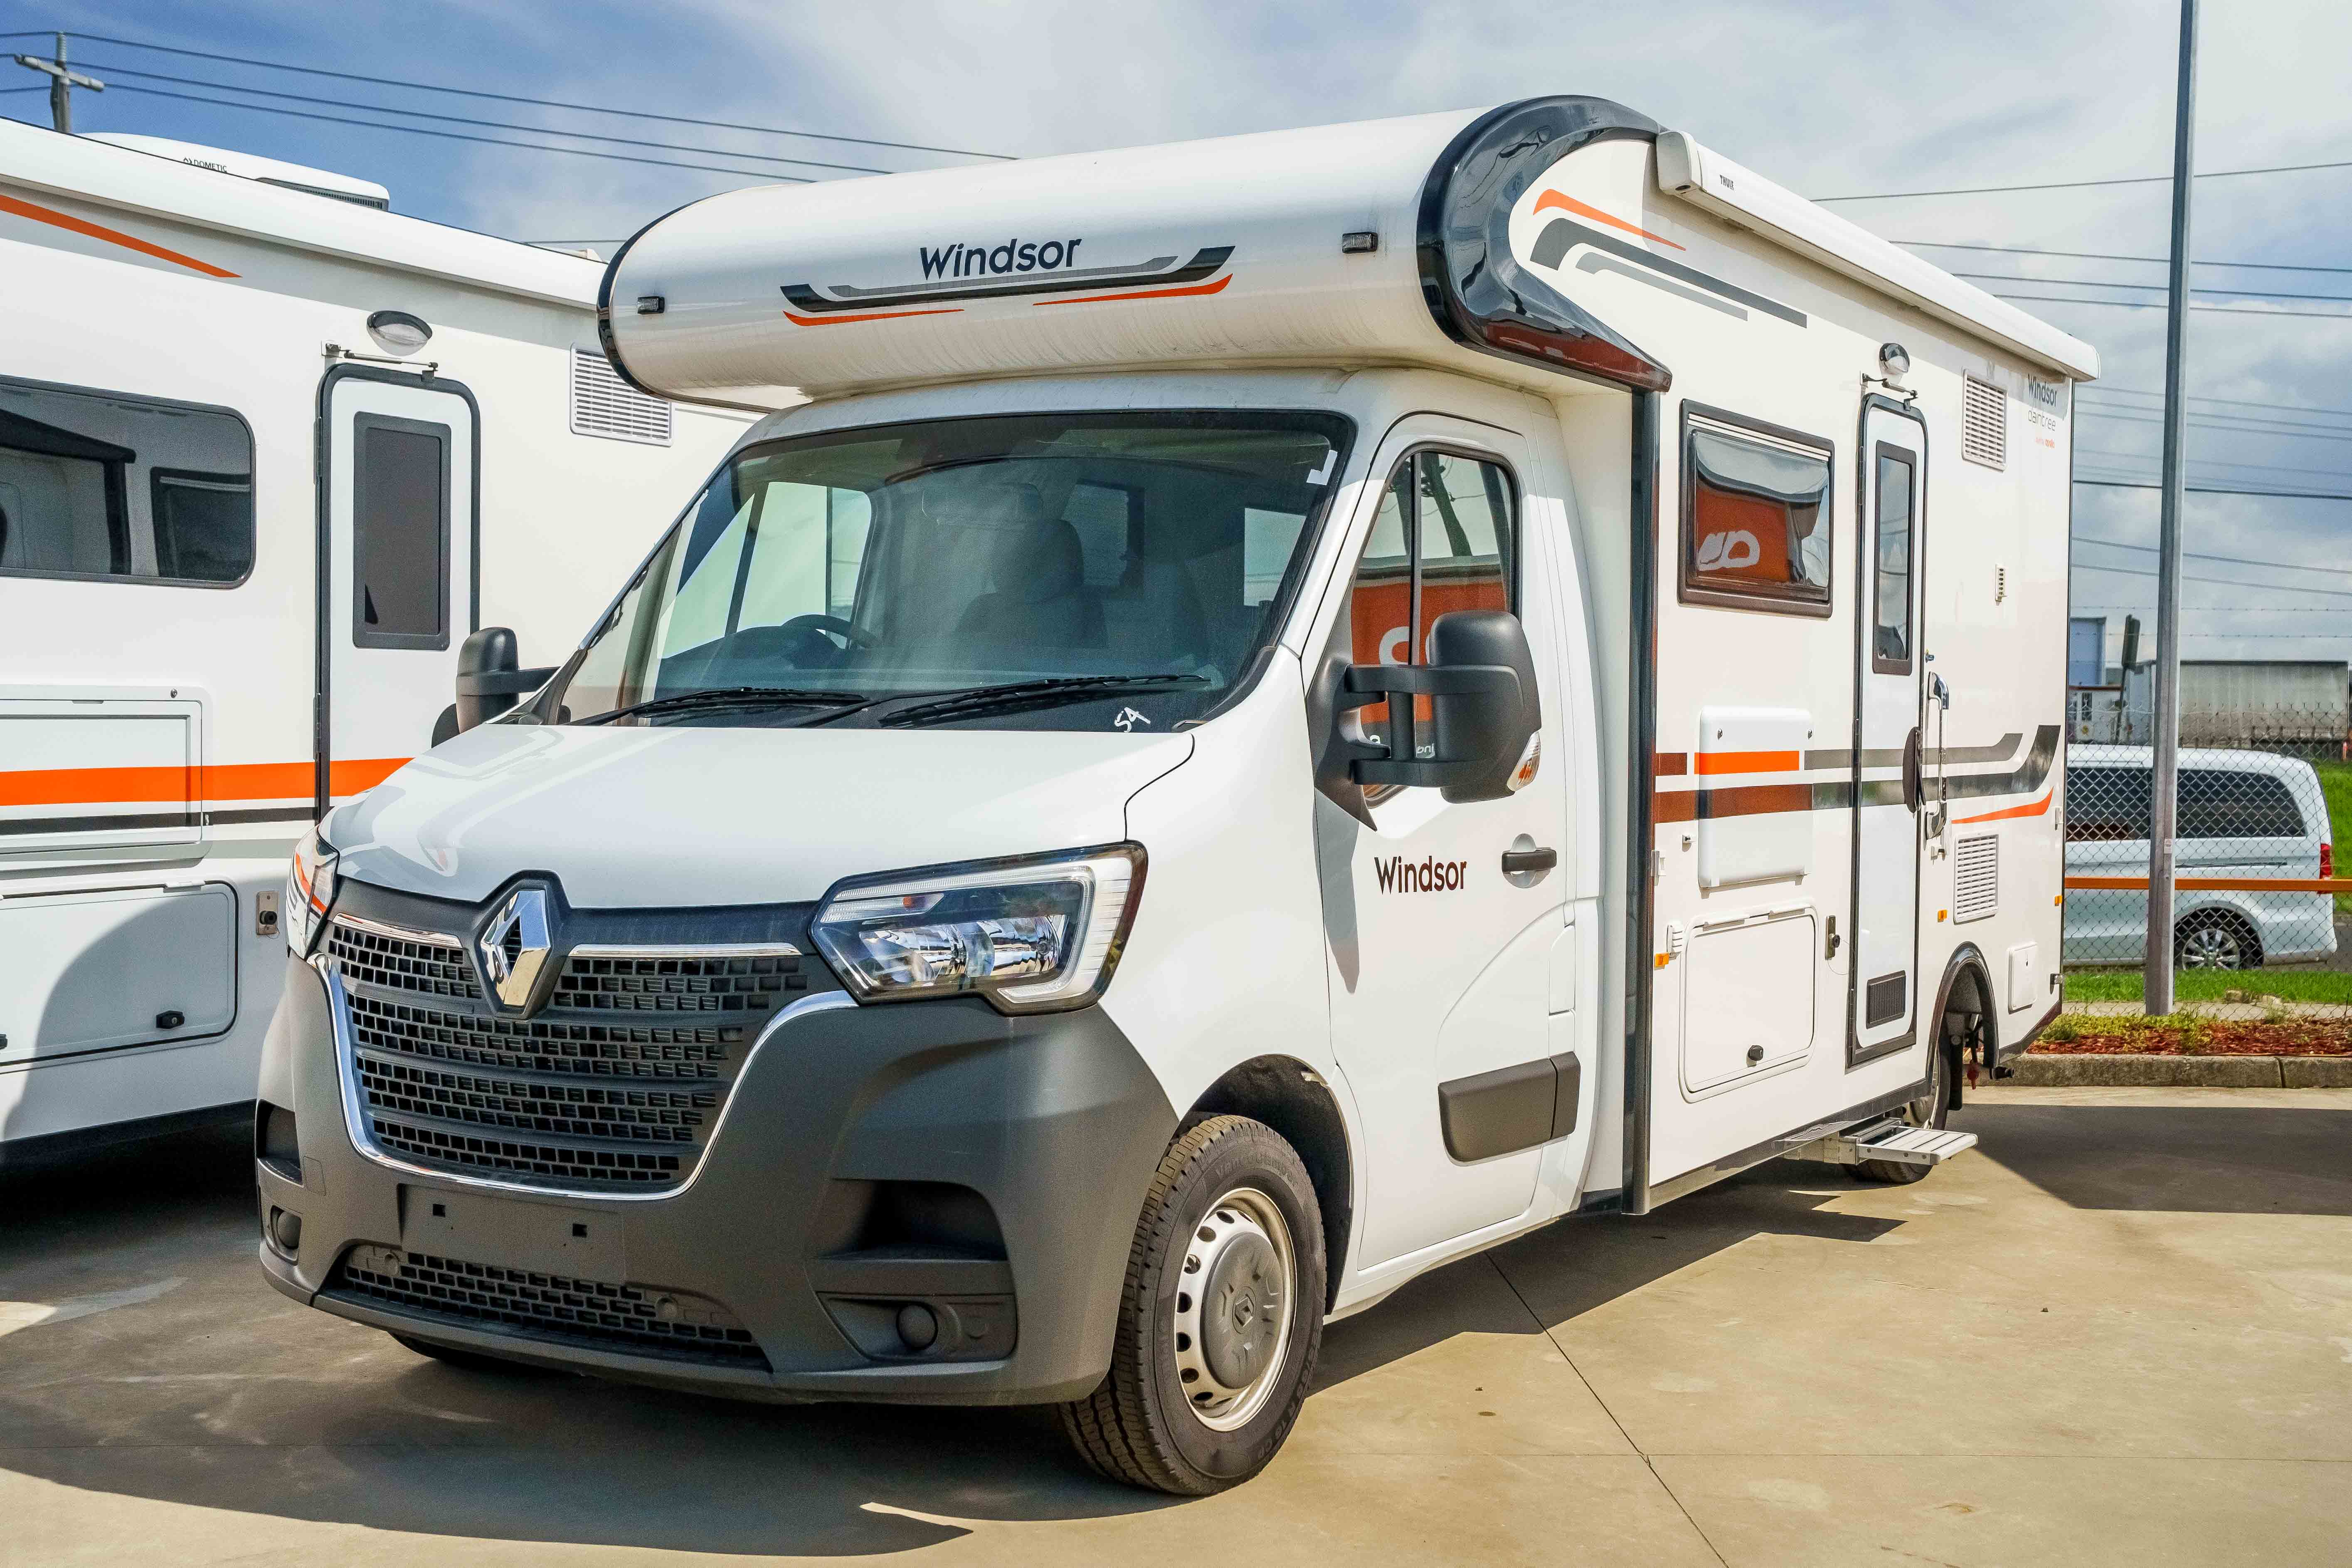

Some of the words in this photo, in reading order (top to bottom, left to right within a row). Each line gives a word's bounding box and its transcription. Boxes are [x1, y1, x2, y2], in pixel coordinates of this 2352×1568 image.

[194, 159, 227, 173] DOMETIC
[1719, 174, 1733, 188] THULE
[920, 238, 1082, 281] Windsor
[2028, 374, 2057, 407] Windsor
[2028, 404, 2056, 431] daintree
[1374, 855, 1467, 895] Windsor
